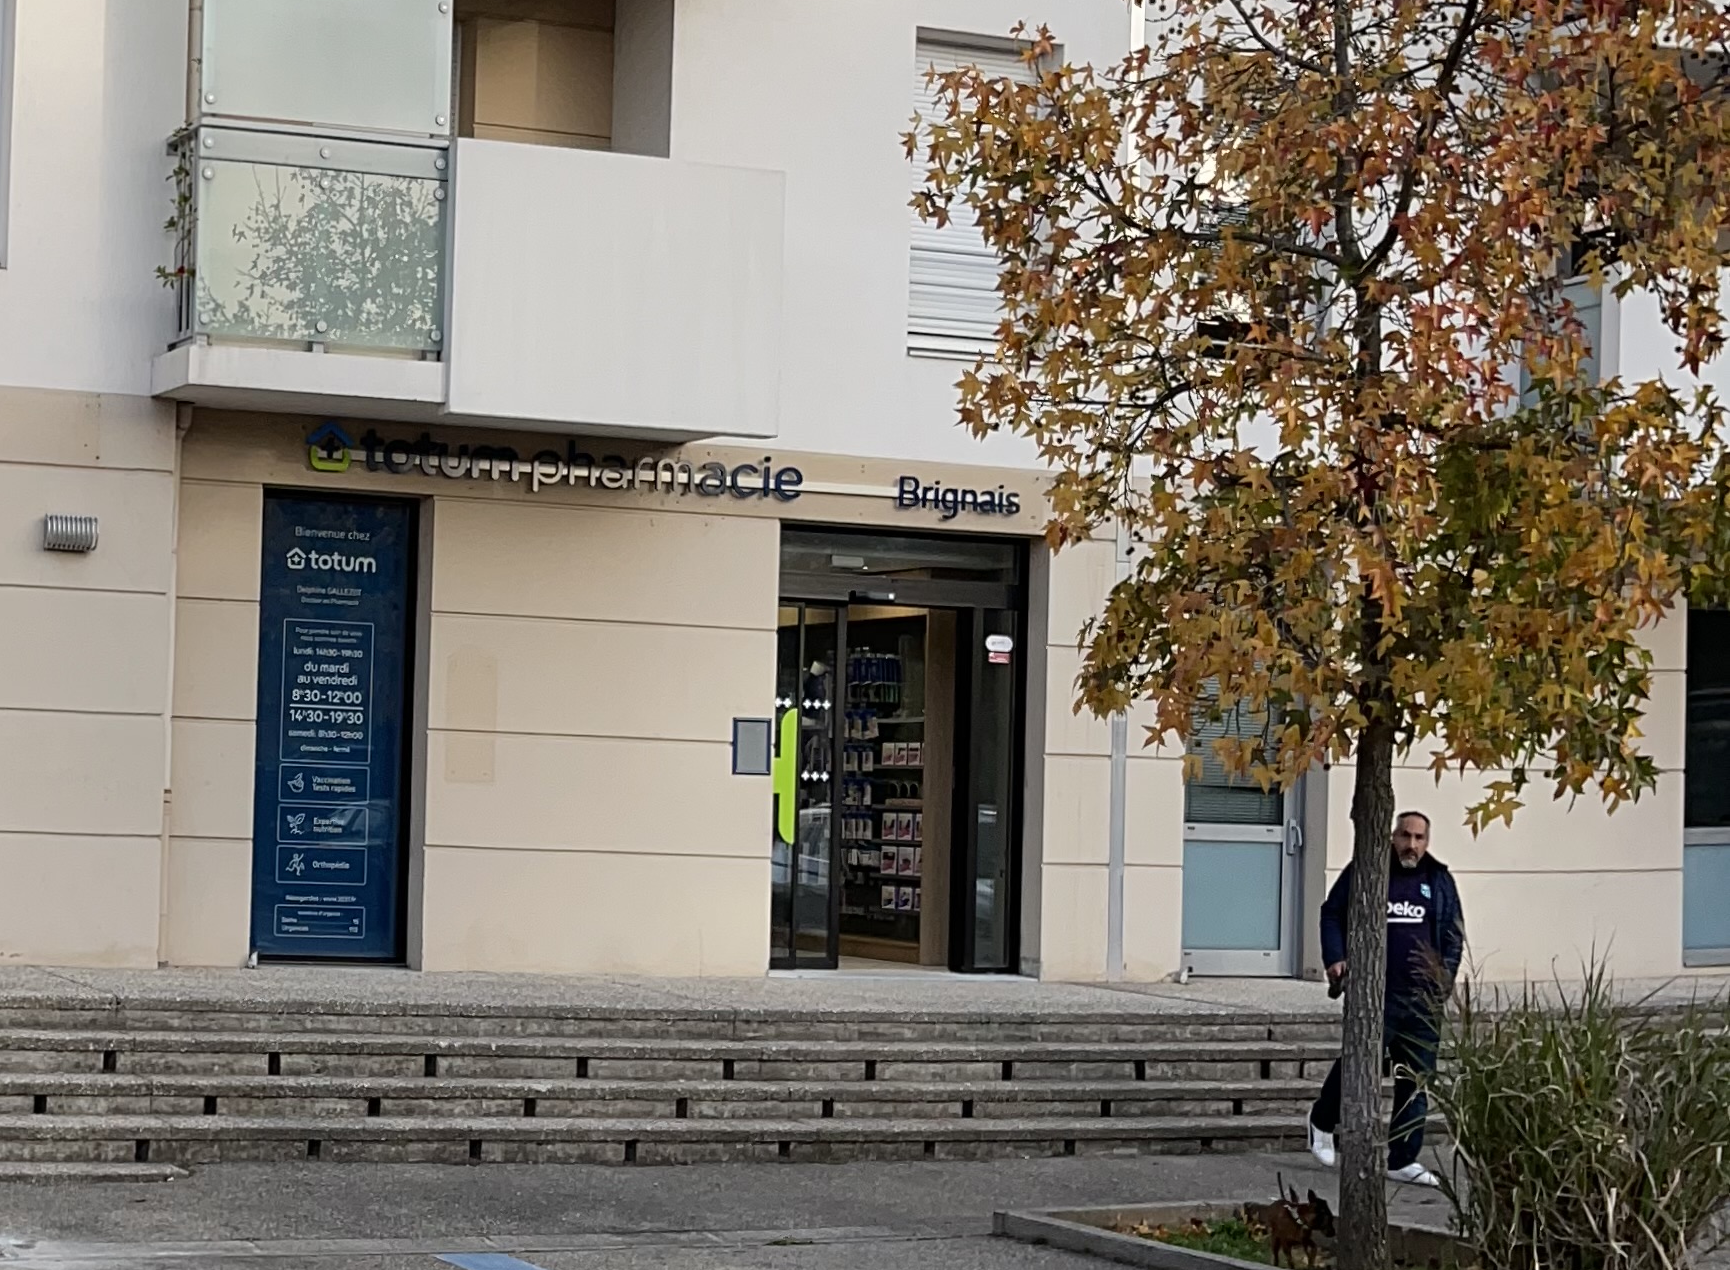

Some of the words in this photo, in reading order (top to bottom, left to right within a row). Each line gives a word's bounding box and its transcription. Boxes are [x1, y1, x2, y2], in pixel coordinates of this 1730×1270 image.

[360, 428, 522, 483] totum
[530, 438, 805, 503] pharmacie
[898, 475, 1021, 520] Brignais
[295, 526, 346, 540] Bienvenue
[347, 530, 371, 541] chez
[308, 550, 377, 573] totum
[304, 661, 318, 672] du
[320, 662, 350, 674] mardi
[297, 675, 310, 684] au
[312, 675, 358, 686] vendredi
